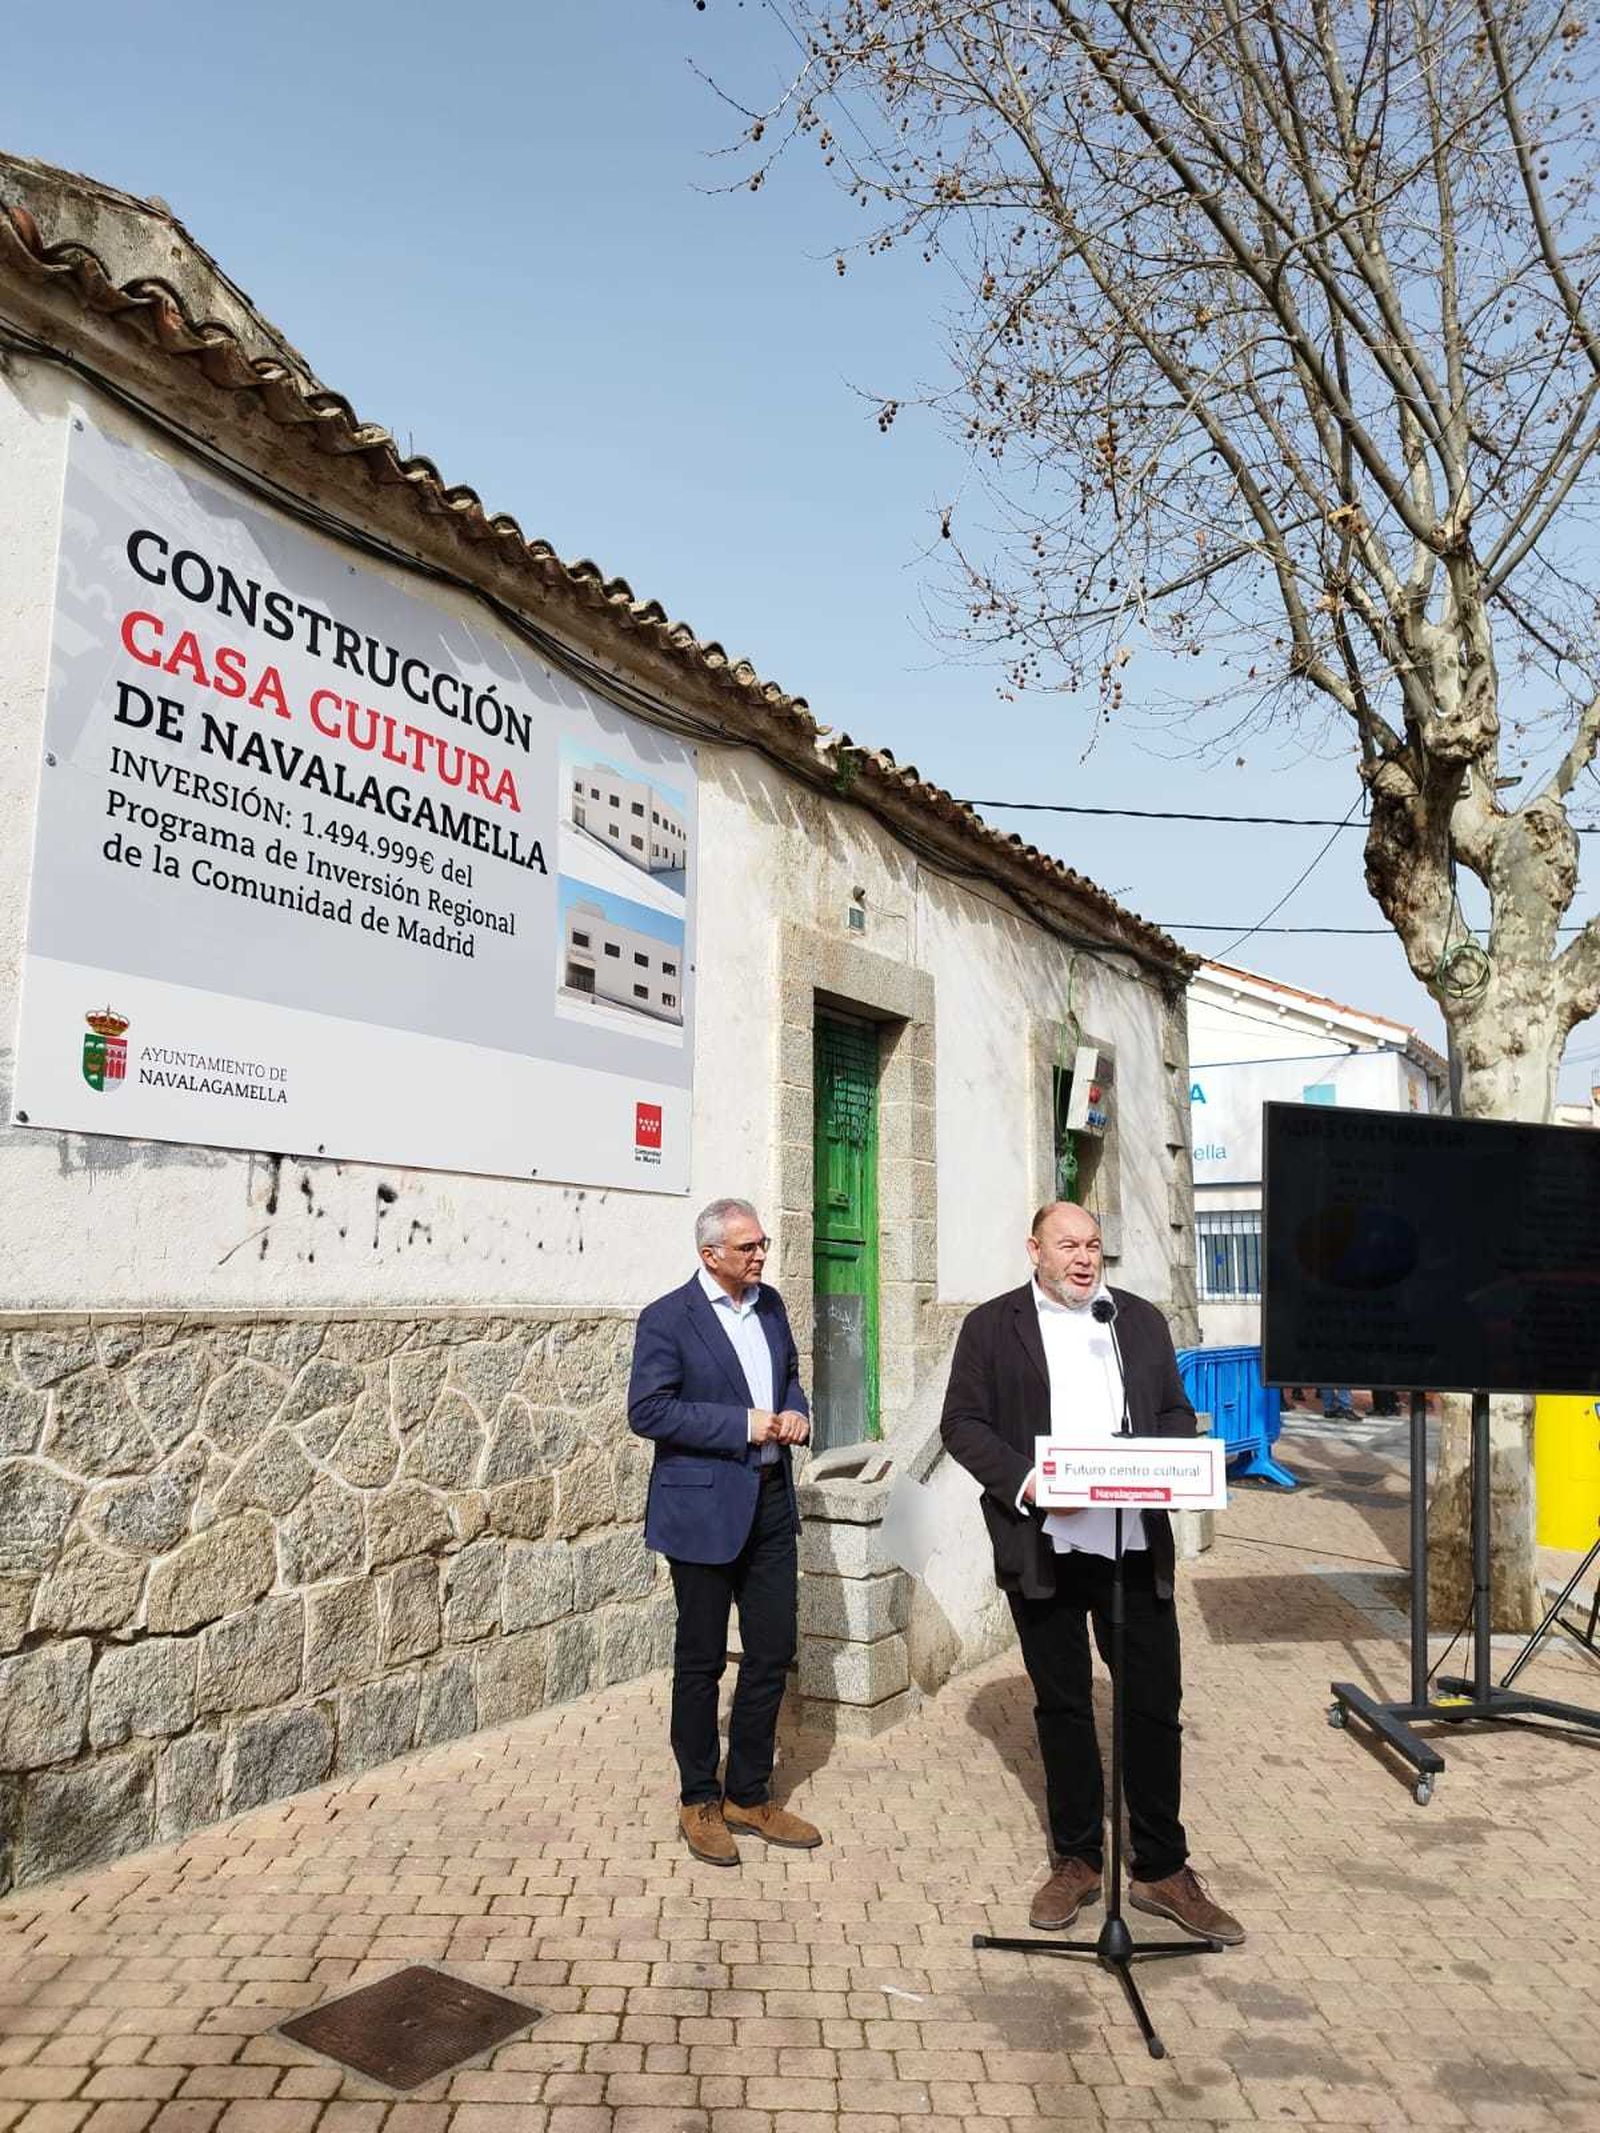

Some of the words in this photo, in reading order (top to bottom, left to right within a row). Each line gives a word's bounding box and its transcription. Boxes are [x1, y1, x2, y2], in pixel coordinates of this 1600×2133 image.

[120, 610, 292, 720] CASA
[309, 689, 521, 813] CULTURA
[126, 529, 532, 753] CONSTRUCCIÓN
[109, 746, 292, 829] INVERSIÓN:
[302, 811, 435, 875] 1.494.999€
[441, 857, 473, 888] del
[114, 681, 185, 743] DE
[200, 712, 549, 876] NAVALAGAMELLA
[103, 833, 142, 868] de
[152, 845, 180, 878] la
[191, 859, 352, 925] Comunidad
[361, 905, 390, 934] de
[398, 915, 475, 958] Madrid
[106, 789, 255, 858] Programa
[265, 838, 298, 870] de
[306, 851, 420, 907] Inversión
[428, 888, 516, 936] Regional
[139, 1069, 288, 1104] NAVALAGAMELLA
[140, 1046, 265, 1078] AYUNTAMIENTO
[269, 1067, 288, 1082] DE
[1064, 1463, 1106, 1477] Futuro
[1109, 1464, 1150, 1477] centro
[1153, 1465, 1200, 1478] cultural
